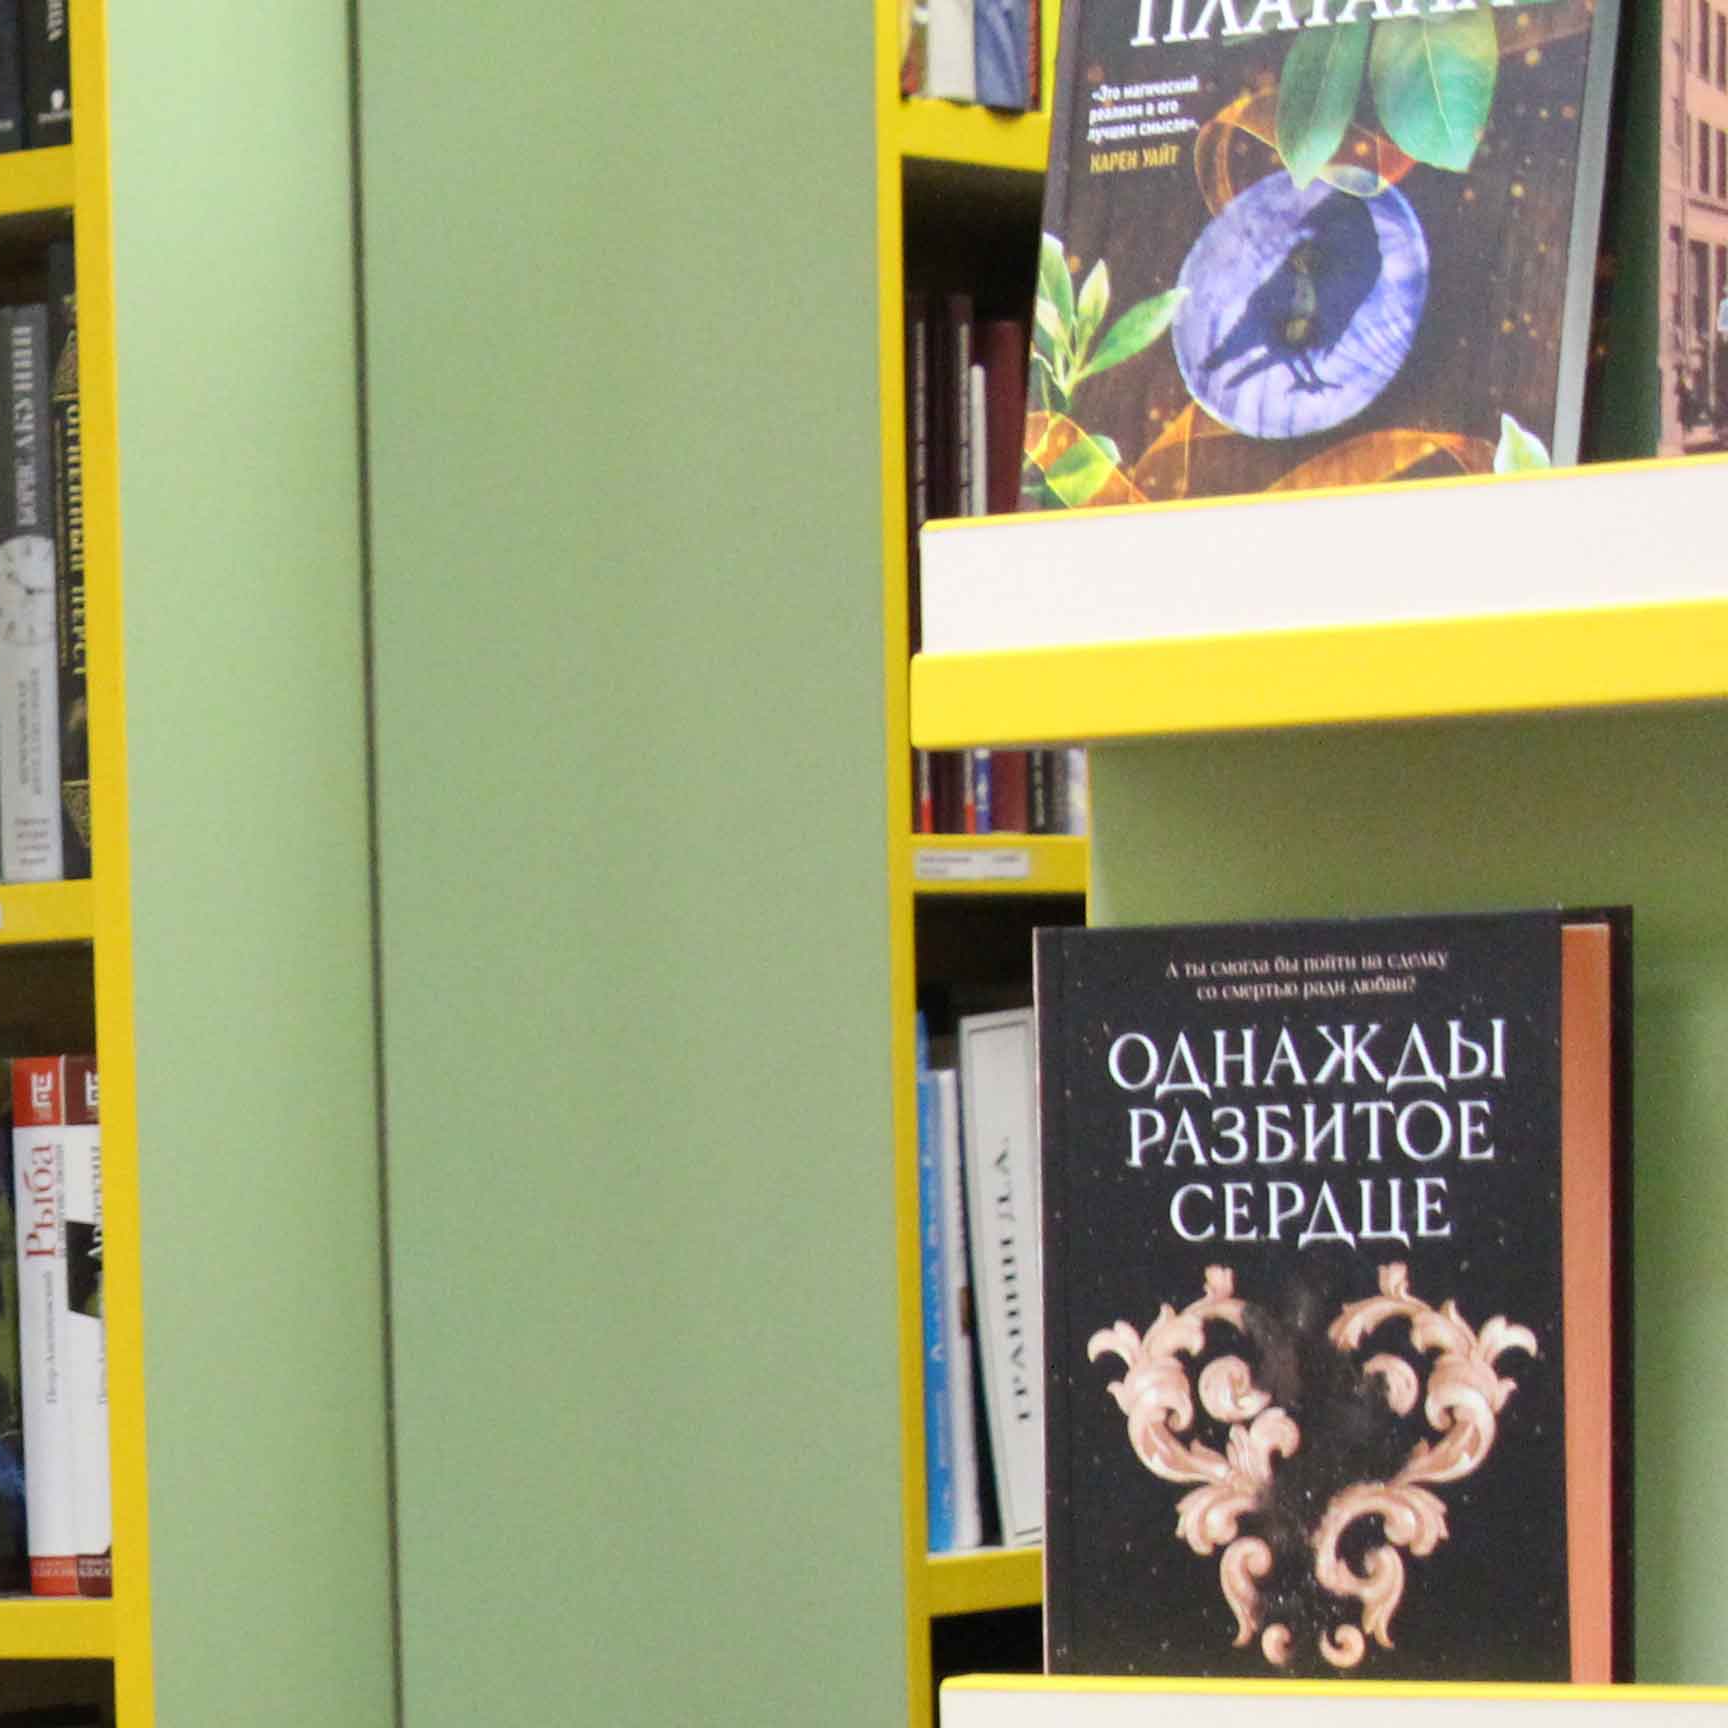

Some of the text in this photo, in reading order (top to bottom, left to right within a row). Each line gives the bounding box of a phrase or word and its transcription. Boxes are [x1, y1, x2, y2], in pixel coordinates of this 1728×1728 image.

[1092, 77, 1198, 100] «Это магический
[1088, 101, 1179, 121] реализм его
[1087, 125, 1137, 141] лучшем
[1090, 145, 1179, 173] КАРЕН УАЙТ
[1165, 950, 1448, 978] А ты смогла бы пойти на сделку
[1196, 976, 1416, 1002] со смертью ради любви?
[1107, 1018, 1507, 1099] ОДНАЖДЫ
[1126, 1099, 1496, 1168] РАЗБИТОЕ
[24, 1144, 57, 1260] Рыба
[1170, 1177, 1452, 1248] СЕРДЦЕ
